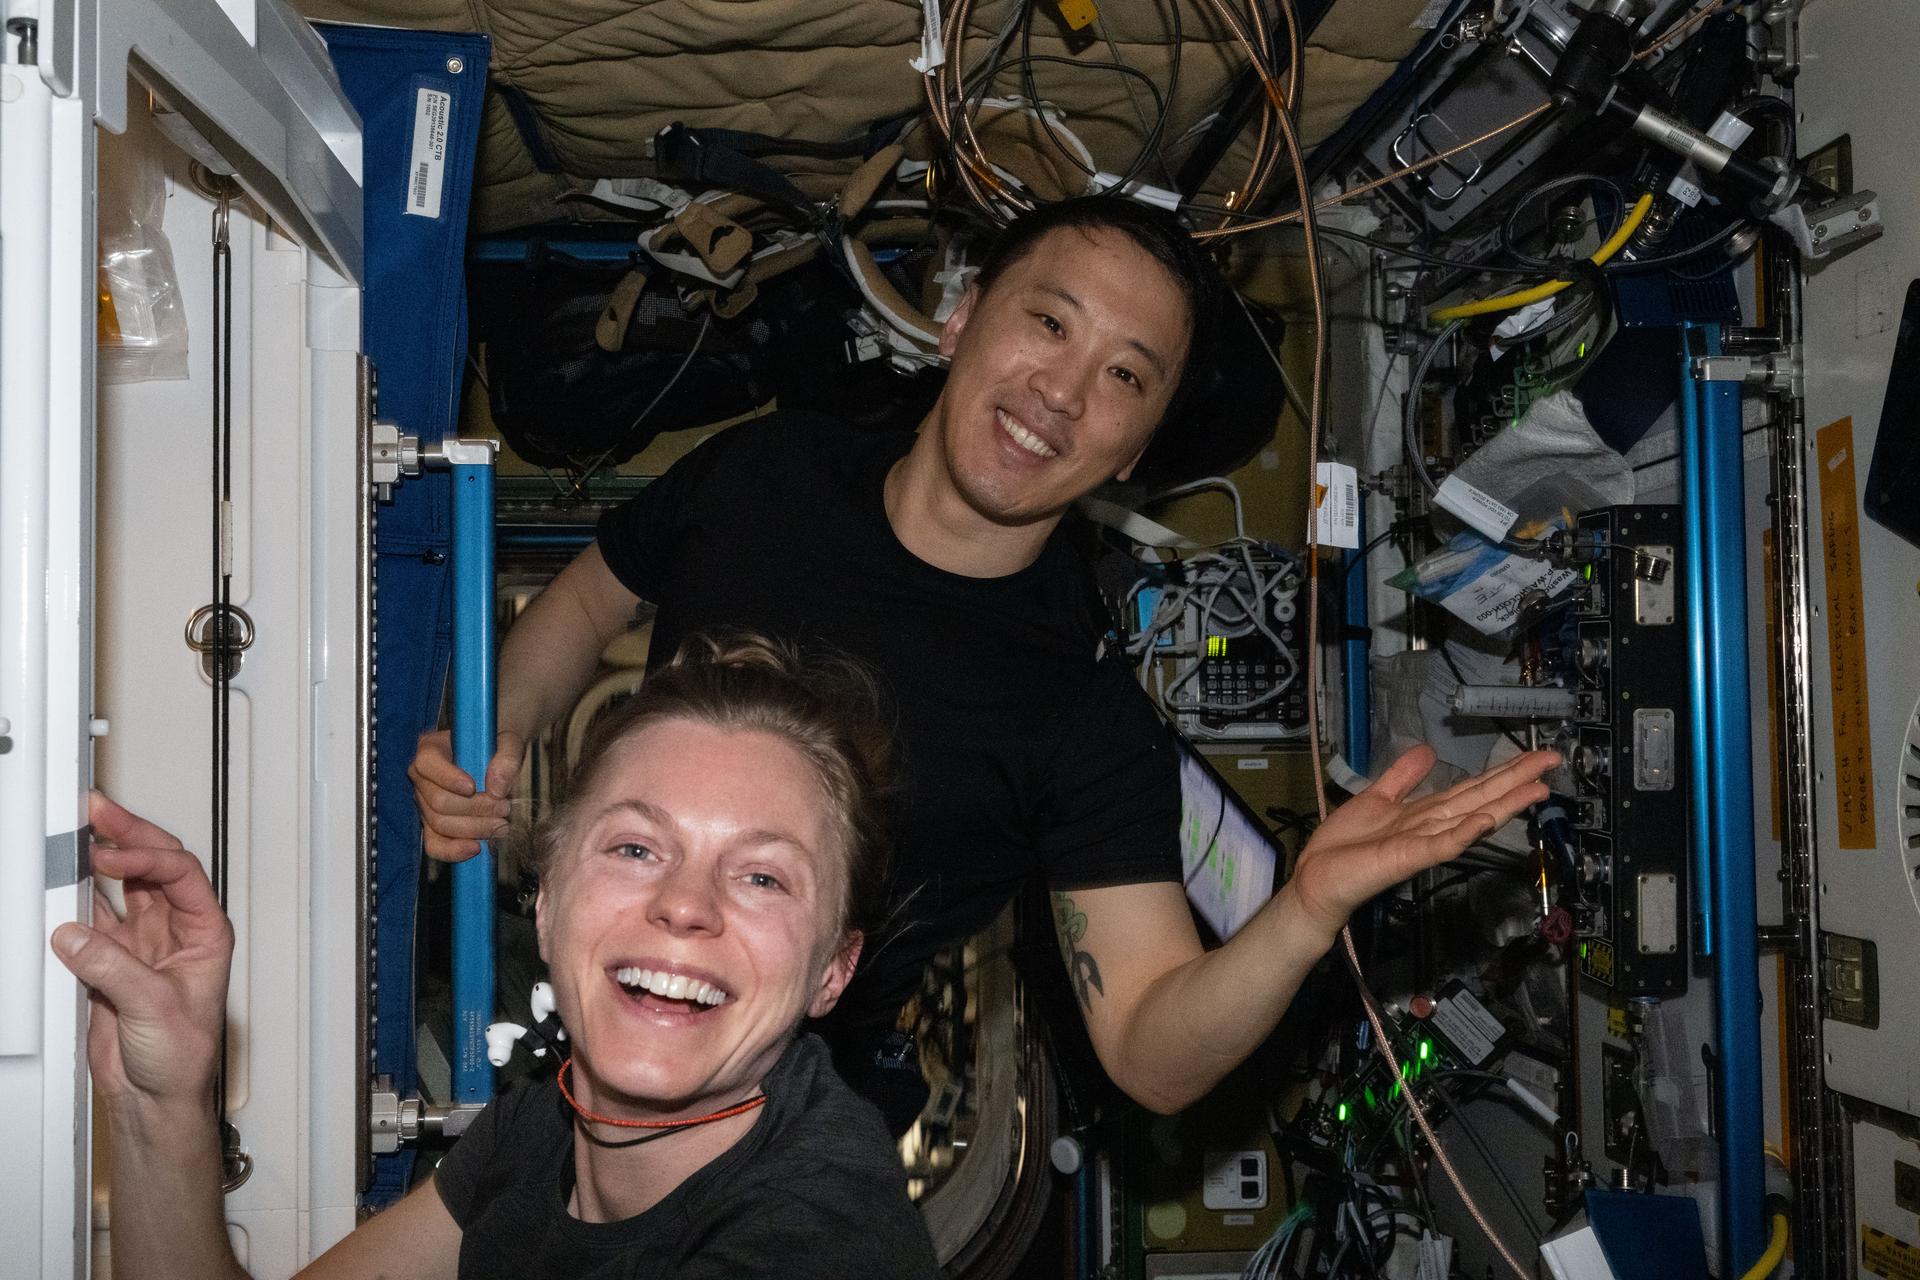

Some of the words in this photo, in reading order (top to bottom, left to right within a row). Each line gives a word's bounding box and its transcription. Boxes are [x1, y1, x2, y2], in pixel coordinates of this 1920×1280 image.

[437, 95, 447, 130] Acoustic
[435, 130, 443, 142] 2.0
[433, 143, 442, 160] CTB
[1857, 773, 1869, 824] PRIOR
